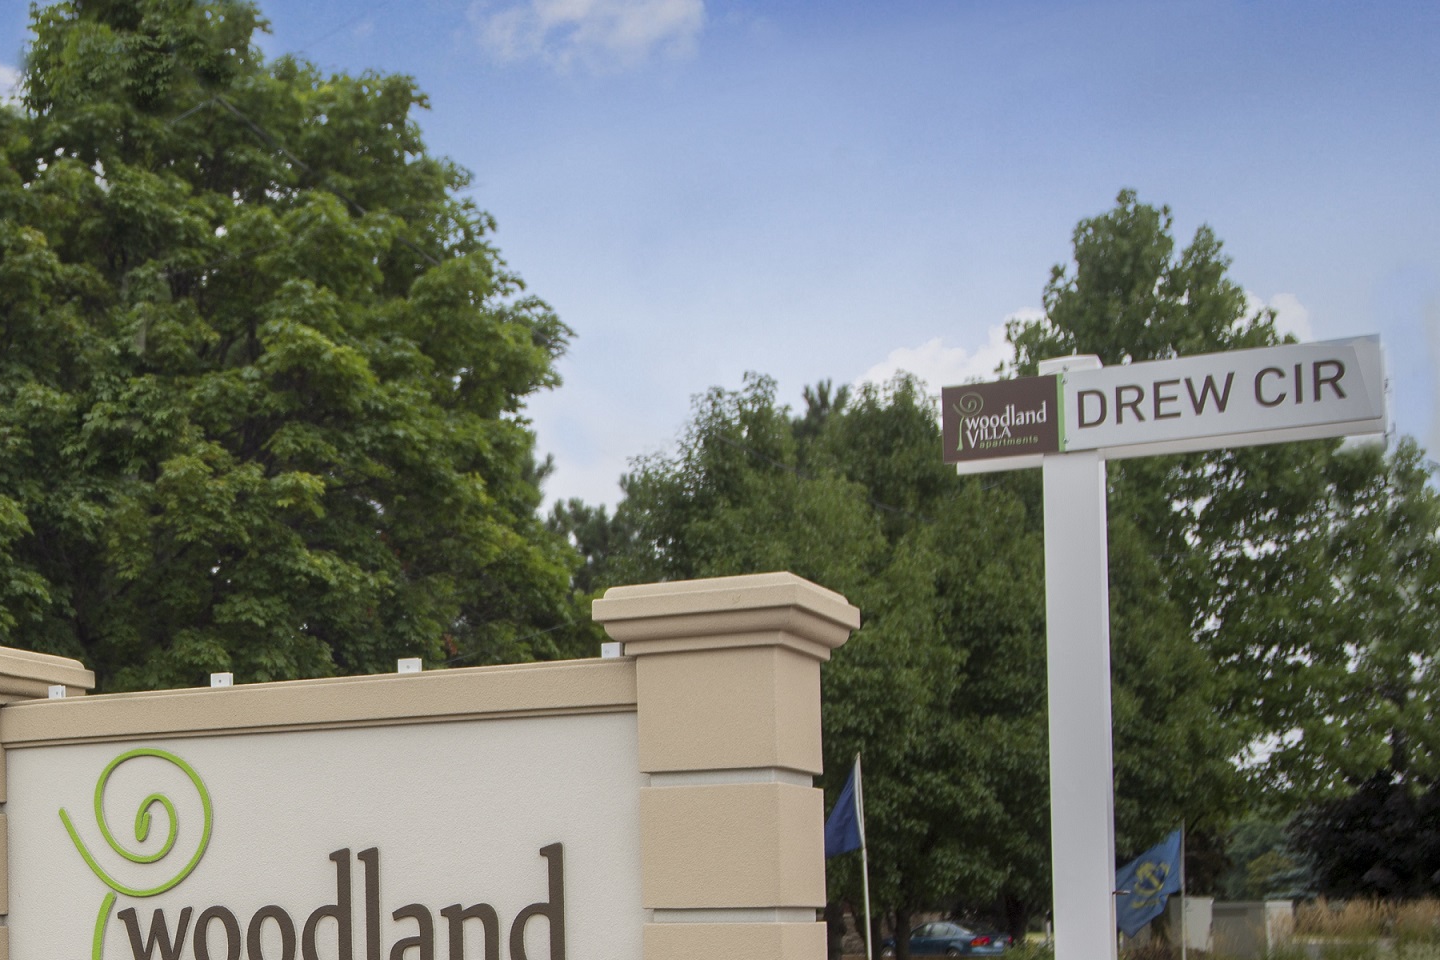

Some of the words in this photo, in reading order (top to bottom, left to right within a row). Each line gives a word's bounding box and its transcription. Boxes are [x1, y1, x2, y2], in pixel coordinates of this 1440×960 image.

[1077, 371, 1235, 429] DREW
[1254, 359, 1347, 408] CIR
[964, 400, 1047, 430] woodland
[965, 426, 1012, 448] VILLA
[979, 434, 1039, 450] apartments
